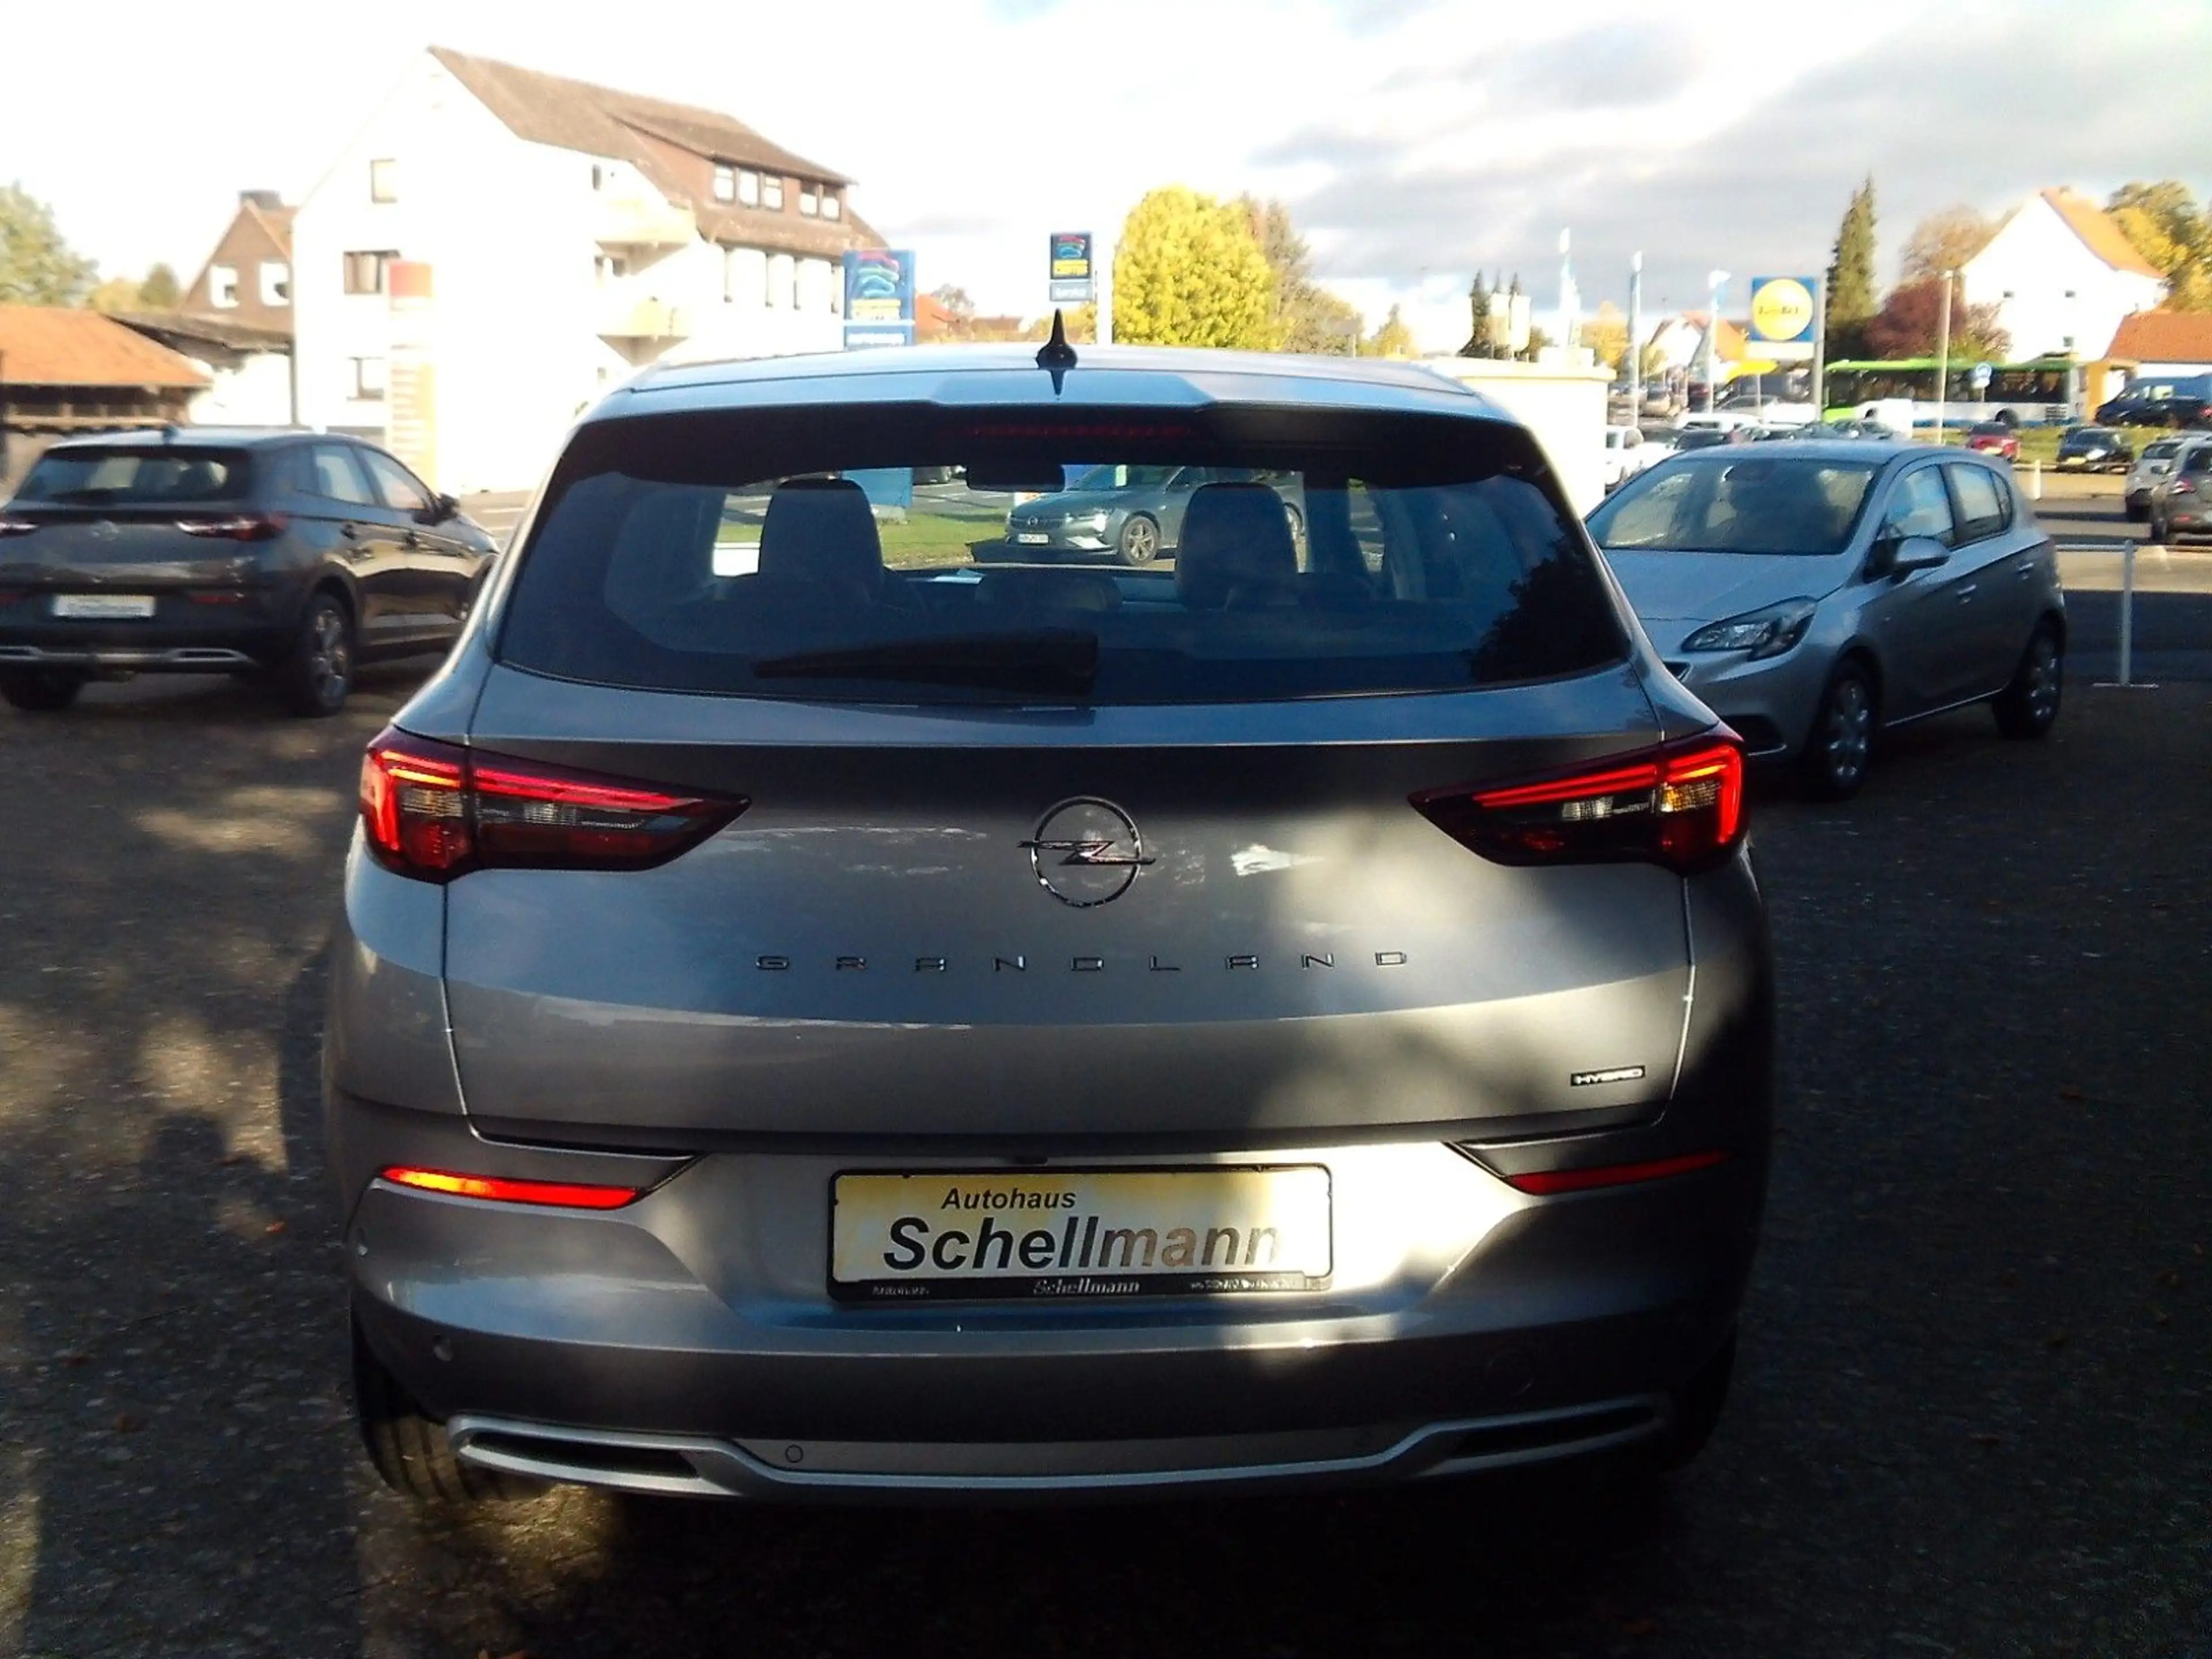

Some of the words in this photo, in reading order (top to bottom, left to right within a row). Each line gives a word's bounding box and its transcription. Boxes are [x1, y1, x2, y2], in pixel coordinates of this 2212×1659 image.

[755, 950, 1407, 972] GRANDLAND
[941, 1188, 1076, 1210] Autohaus
[884, 1216, 1279, 1270] Schellmann
